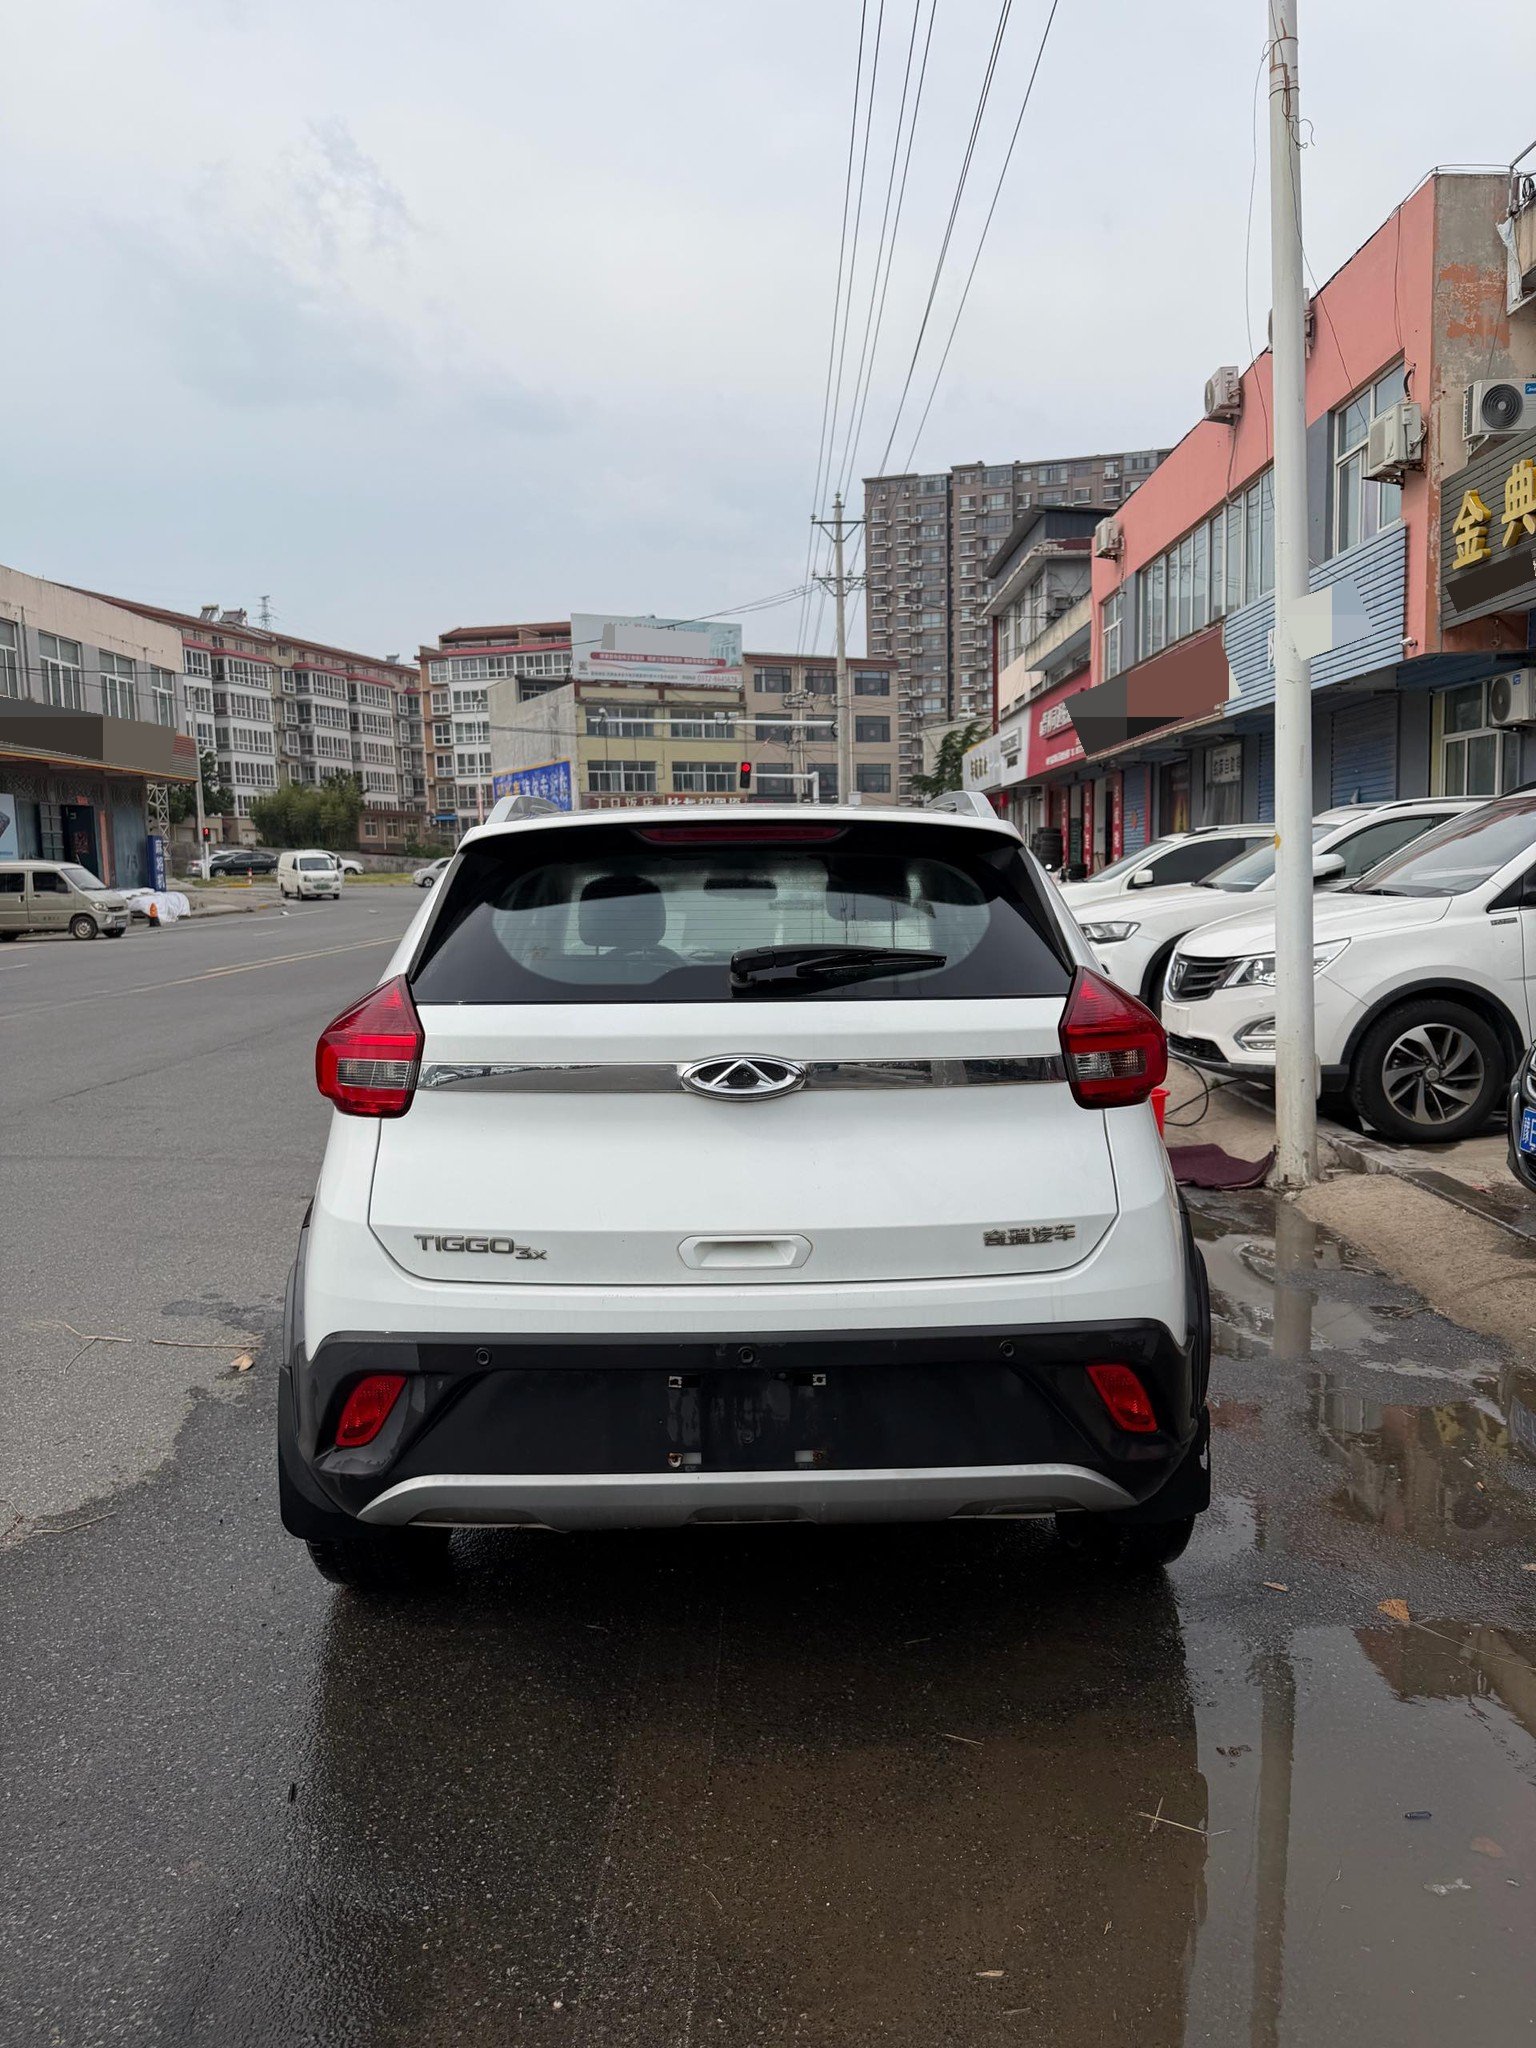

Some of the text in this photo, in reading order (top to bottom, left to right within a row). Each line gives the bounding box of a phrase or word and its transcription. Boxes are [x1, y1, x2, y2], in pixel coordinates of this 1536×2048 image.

[1452, 459, 1536, 570] 金典
[983, 1224, 1075, 1246] 奇瑞汽车
